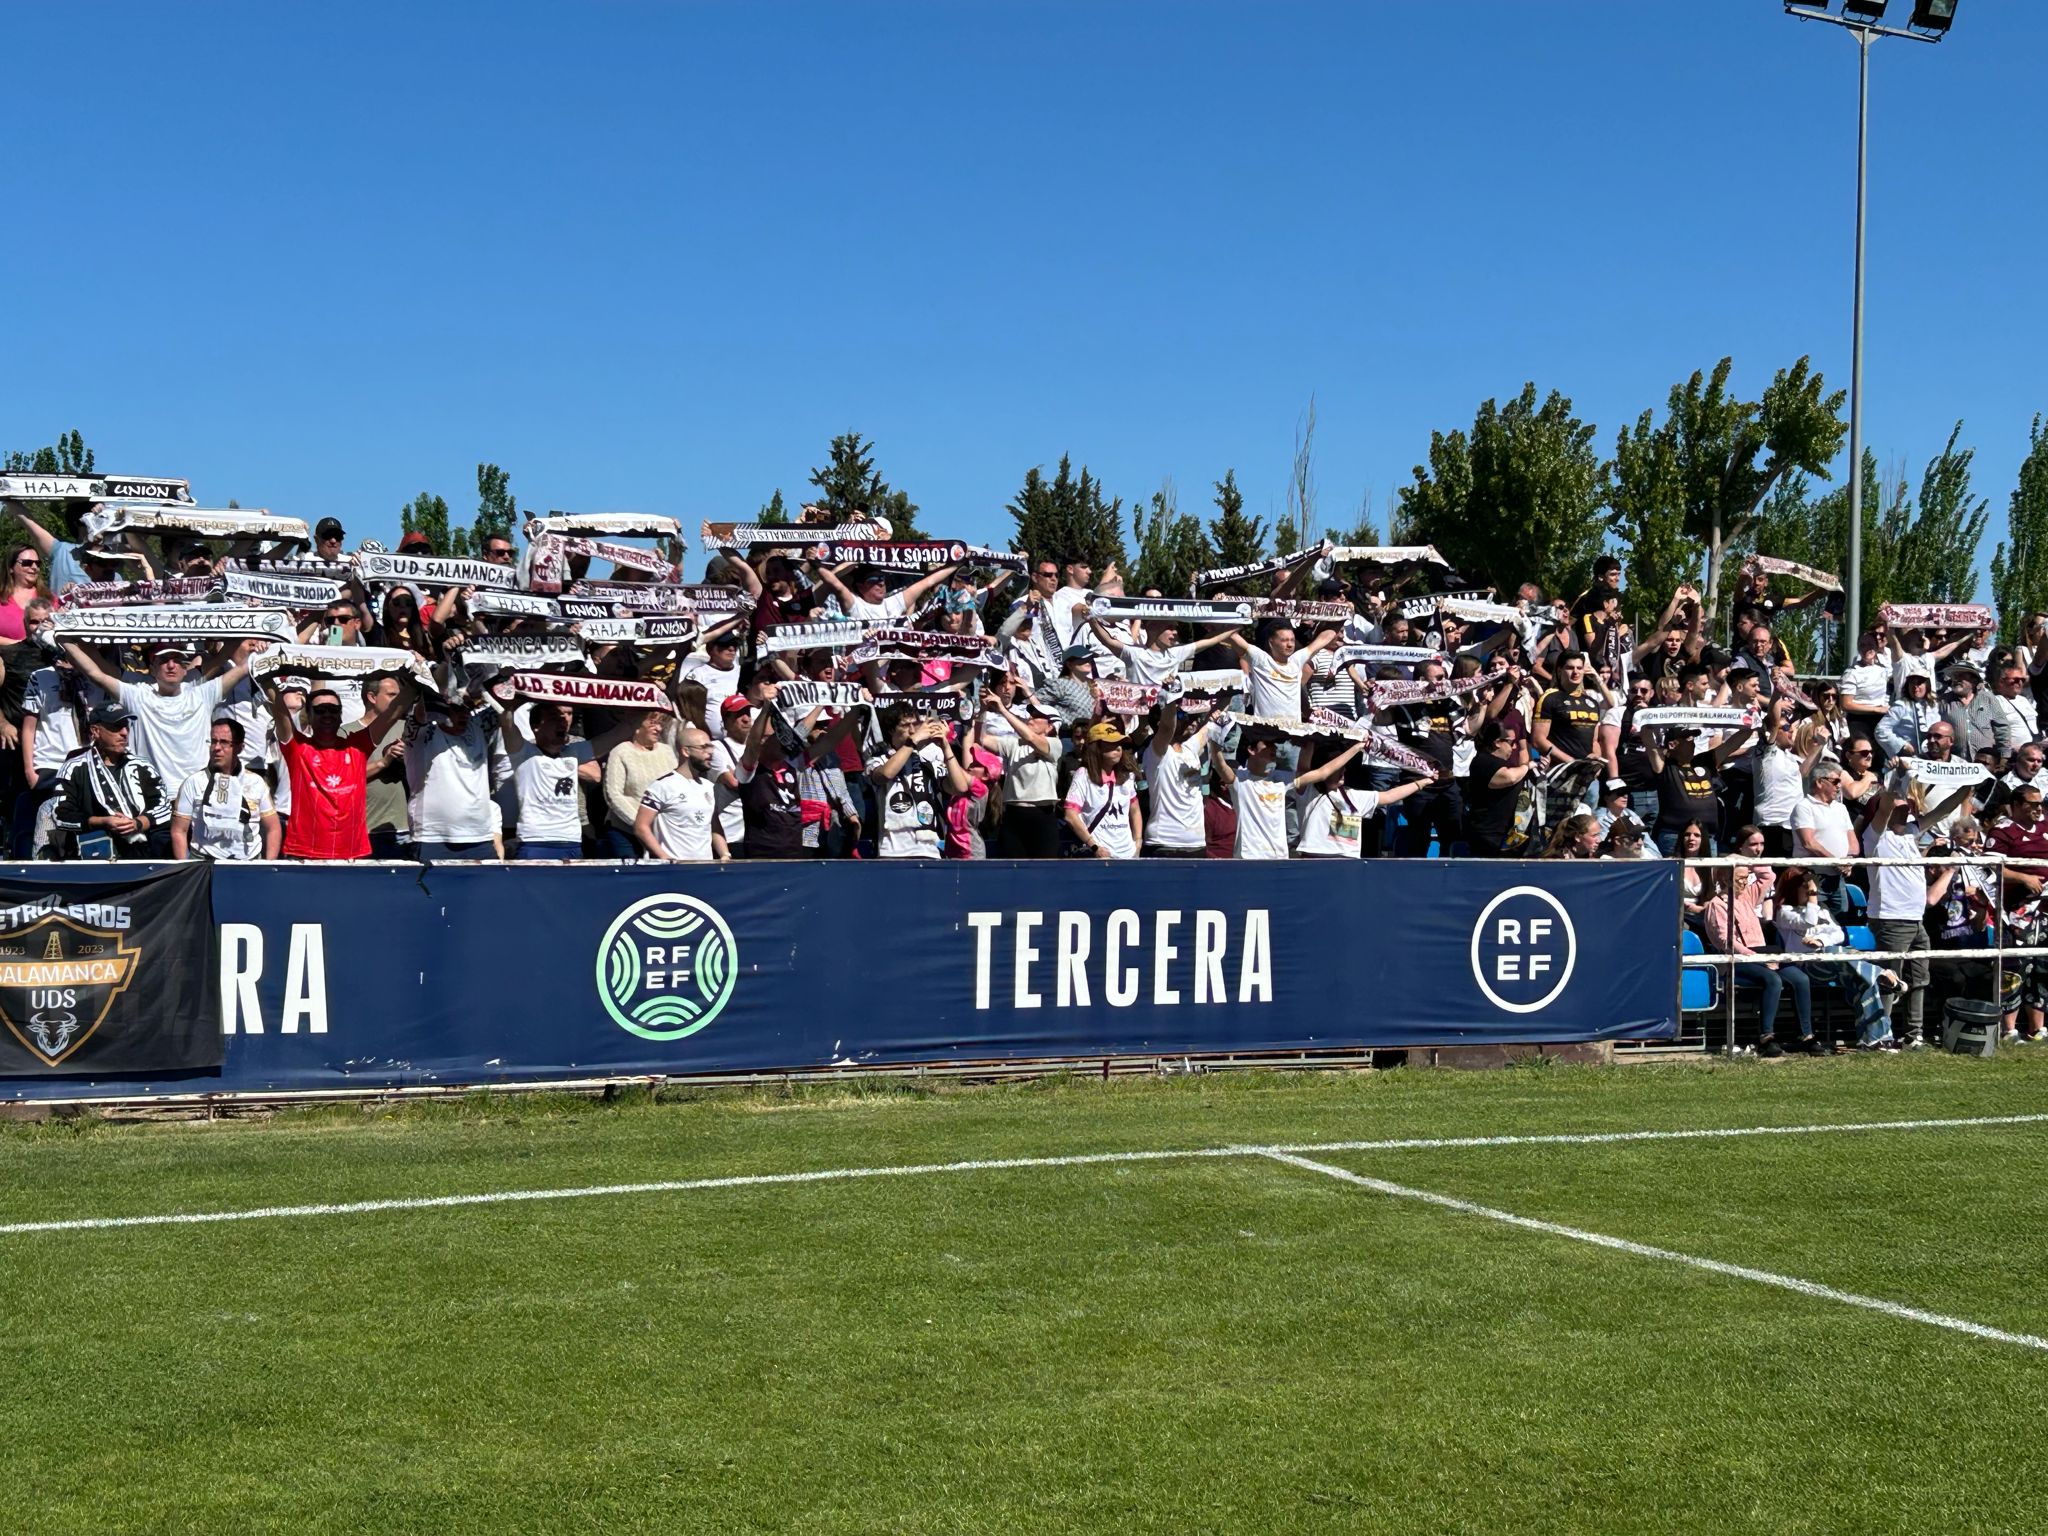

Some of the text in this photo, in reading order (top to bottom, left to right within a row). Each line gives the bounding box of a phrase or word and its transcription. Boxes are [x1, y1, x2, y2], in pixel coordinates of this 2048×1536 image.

[24, 481, 79, 494] HALA
[133, 514, 238, 531] SALAMANCA
[834, 546, 949, 563] LOCOS X LA UDS
[425, 562, 504, 584] SALAMANCA
[497, 598, 542, 613] HALA
[81, 612, 256, 630] U.D. SALAMANCA
[589, 624, 628, 637] HALA
[254, 655, 375, 671] SALAMANCA
[514, 675, 656, 703] U.D. SALAMANCA
[937, 697, 956, 709] UDS
[1926, 762, 1980, 775] Salmantino
[1498, 918, 1552, 945] RF
[77, 944, 104, 954] 2023
[646, 947, 690, 965] RF
[967, 908, 1273, 1010] TERCERA
[1497, 955, 1551, 981] EF
[0, 962, 118, 984] ALAMANCA
[220, 922, 329, 1034] RA
[645, 971, 690, 990] EF
[31, 988, 77, 1009] UDS
